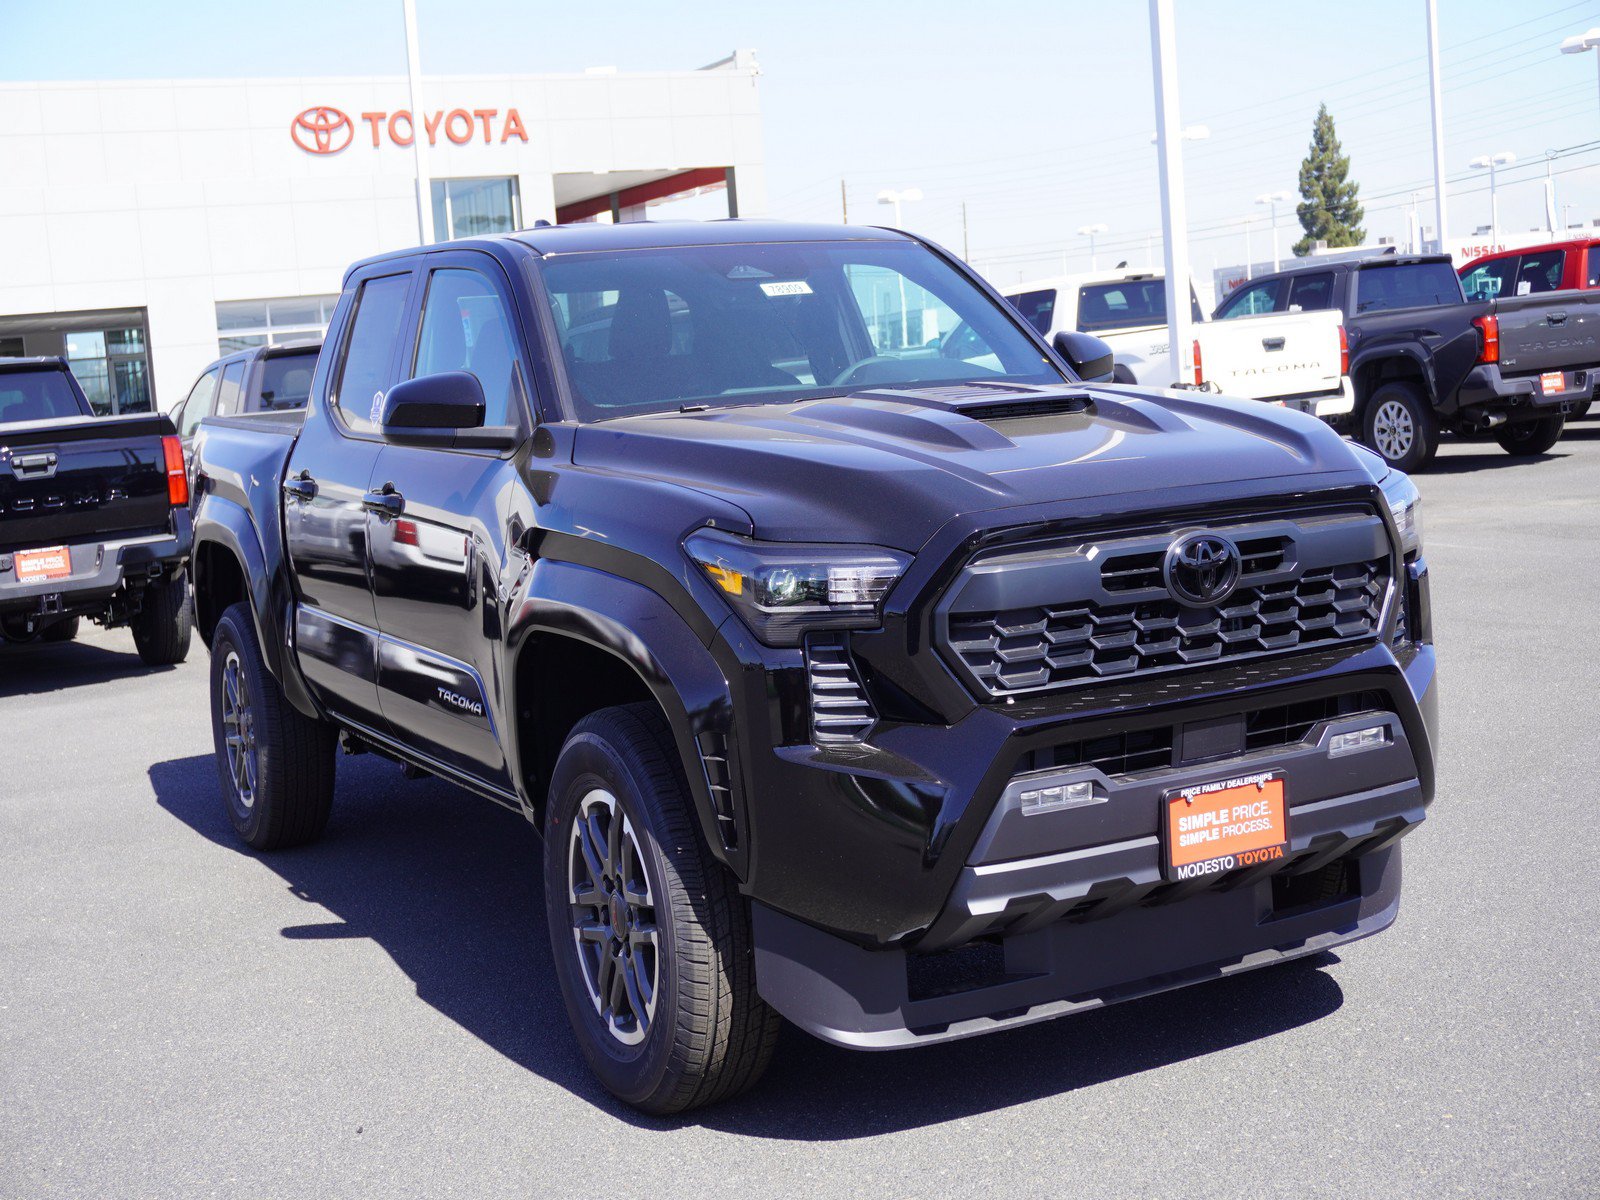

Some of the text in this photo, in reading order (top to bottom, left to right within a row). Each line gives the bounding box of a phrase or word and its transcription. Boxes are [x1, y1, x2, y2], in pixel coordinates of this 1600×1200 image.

[361, 109, 529, 148] TOYOTA
[1519, 336, 1596, 352] TACOMA
[1231, 361, 1321, 377] TACOMA
[437, 686, 483, 716] TACOMA
[1180, 772, 1273, 798] PRICE FAMILY DEALERSHIPS
[1178, 800, 1272, 832] SIMPLE PRICE.
[1179, 817, 1273, 847] SIMPLE PROCESS.
[1177, 845, 1283, 880] MODESTO TOYOTA
